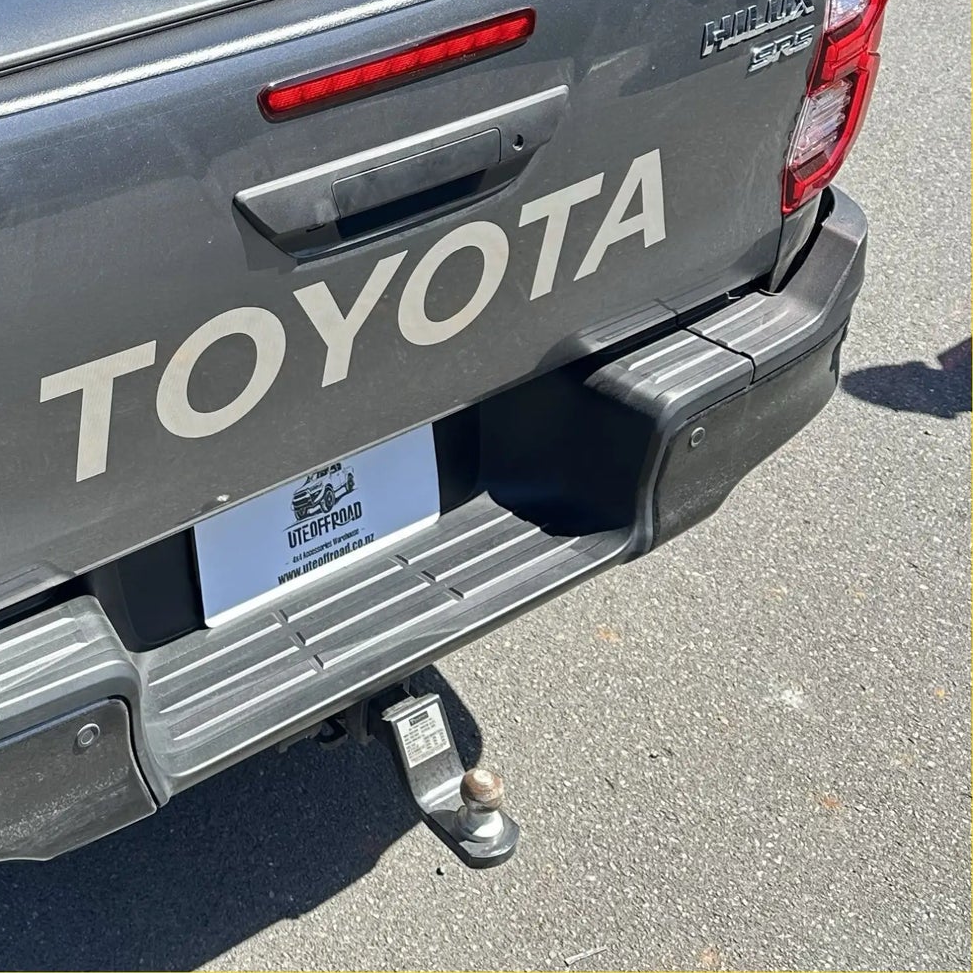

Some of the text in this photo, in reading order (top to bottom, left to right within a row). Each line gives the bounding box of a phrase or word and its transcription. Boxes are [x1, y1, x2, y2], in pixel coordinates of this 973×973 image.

[748, 24, 815, 73] SR5
[40, 148, 666, 482] TOYOTA
[287, 501, 362, 549] UTEOFFROAD
[302, 540, 333, 559] Accessories
[332, 528, 360, 546] Warehouse
[277, 532, 375, 585] www.uteoffroad.co.nz
